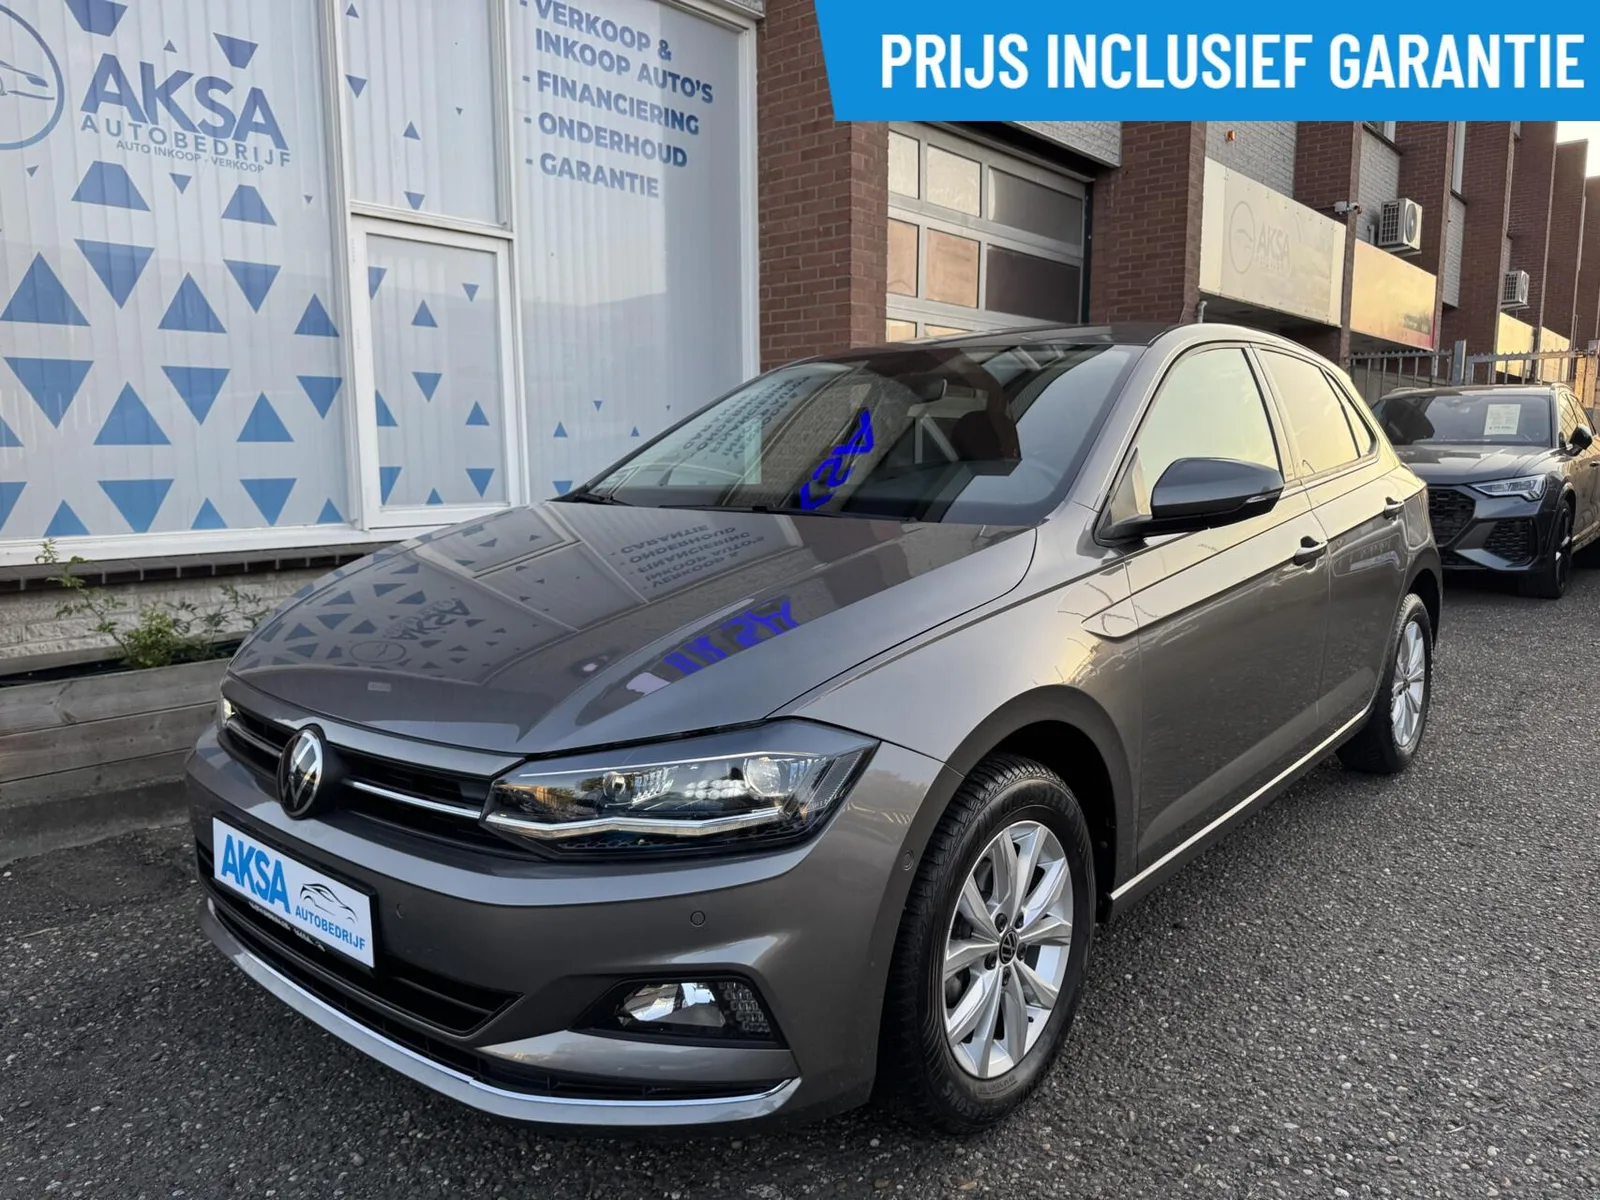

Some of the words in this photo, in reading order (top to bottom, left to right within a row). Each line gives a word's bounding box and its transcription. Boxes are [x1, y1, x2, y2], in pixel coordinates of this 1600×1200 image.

[535, 0, 651, 51] VERKOOP
[657, 39, 672, 61] &
[535, 28, 631, 76] INKOOP
[637, 63, 714, 104] AUTO'S
[80, 53, 289, 150] AKSA
[537, 70, 700, 136] FINANCIERING
[80, 114, 291, 168] AUTOBEDRIJF
[116, 139, 151, 155] AUTO
[154, 145, 201, 163] INKOOP
[211, 157, 265, 174] VERKOOP
[538, 111, 687, 168] ONDERHOUD
[540, 152, 659, 198] GARANTIE
[1256, 220, 1291, 266] AKSA
[221, 834, 291, 914] AKSA
[295, 905, 366, 950] AUTOBEDRIJF
